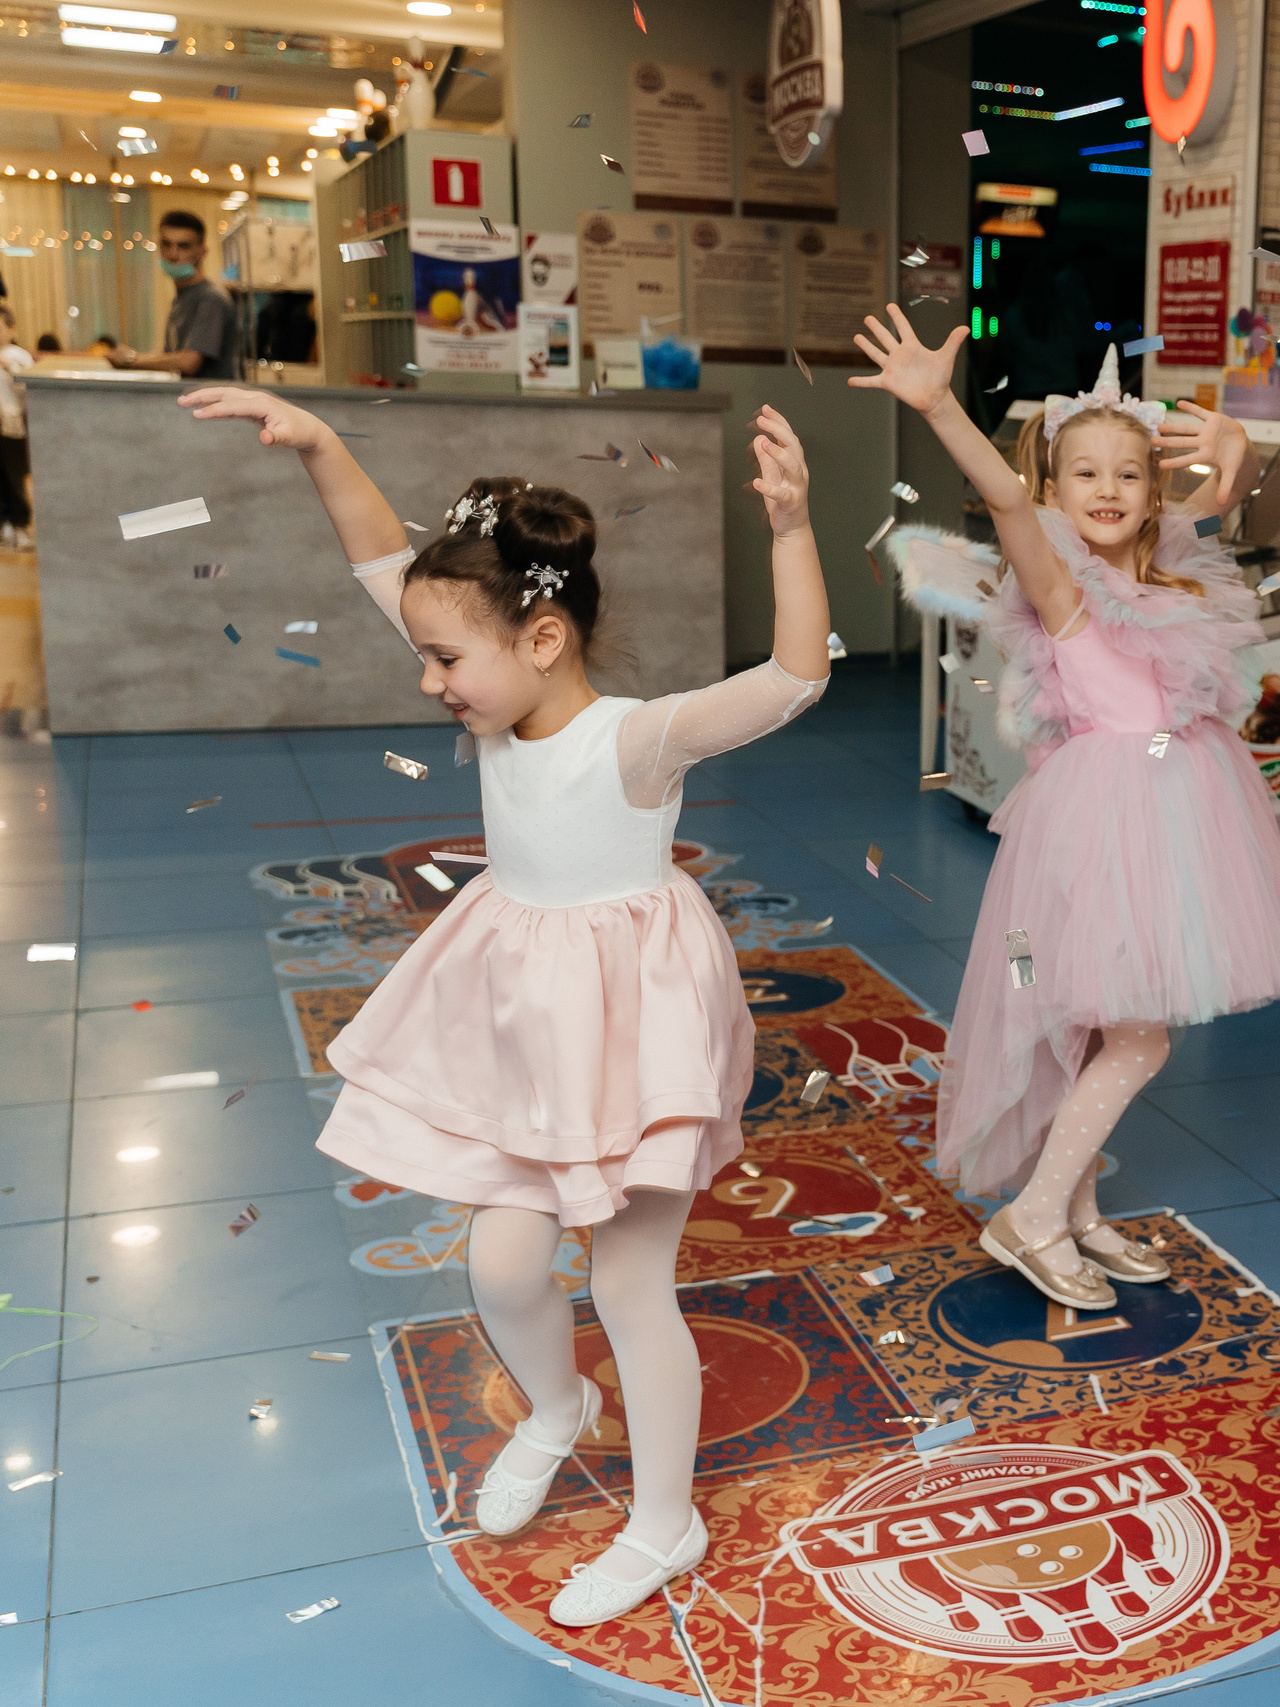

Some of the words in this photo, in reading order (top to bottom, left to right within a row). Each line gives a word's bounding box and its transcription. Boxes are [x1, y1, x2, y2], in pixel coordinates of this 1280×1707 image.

[1163, 184, 1231, 218] бублик
[958, 1465, 1048, 1487] БОУЛИНГ
[818, 1464, 1168, 1558] МОСКВА
